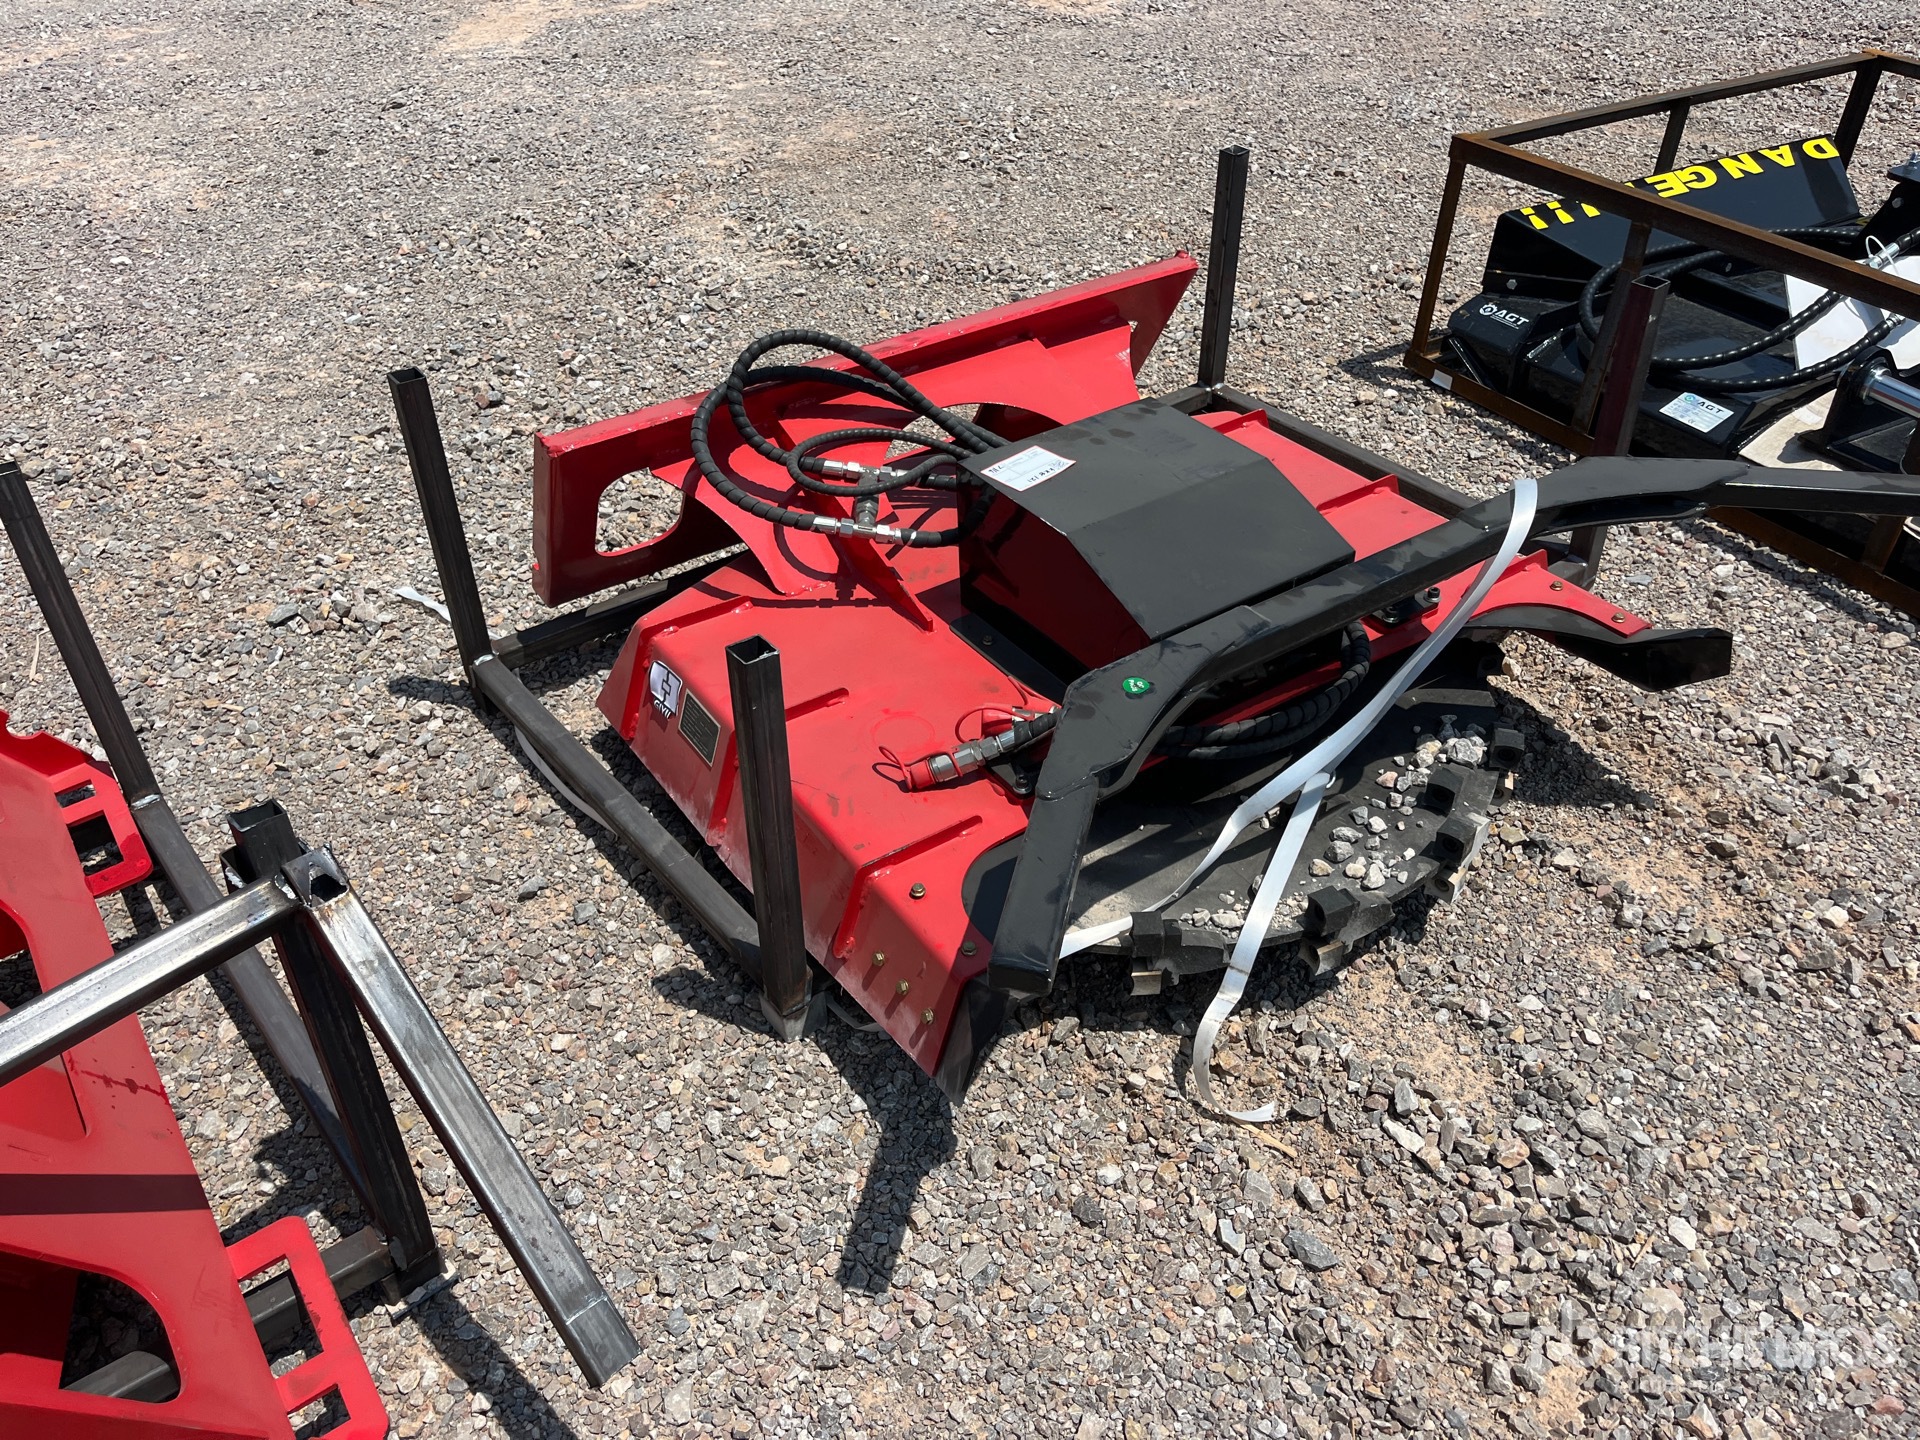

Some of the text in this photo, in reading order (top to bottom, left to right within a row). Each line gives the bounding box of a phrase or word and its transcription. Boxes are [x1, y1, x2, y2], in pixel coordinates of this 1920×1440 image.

[1623, 137, 1841, 199] DANGE
[1494, 309, 1530, 325] AGT
[1697, 401, 1724, 414] AGT
